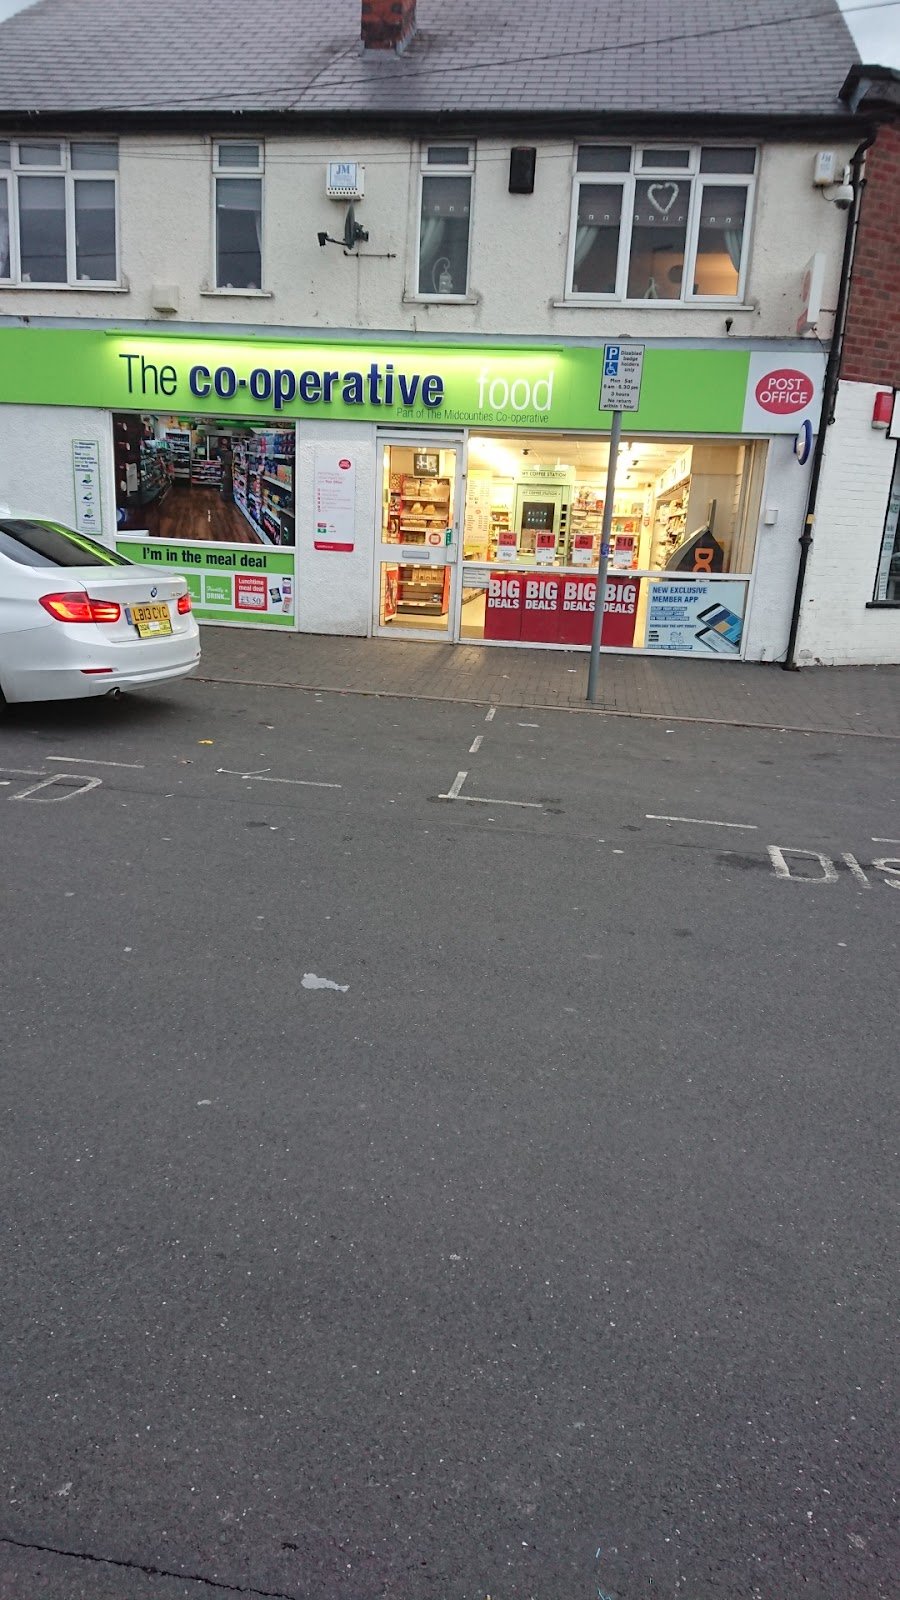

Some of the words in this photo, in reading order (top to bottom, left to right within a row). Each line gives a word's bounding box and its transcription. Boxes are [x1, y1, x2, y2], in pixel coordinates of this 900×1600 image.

[336, 164, 350, 174] JM
[609, 348, 618, 359] P
[119, 354, 177, 395] The
[476, 366, 554, 411] food
[768, 378, 804, 390] POST
[760, 391, 808, 404] OFFICE
[397, 407, 413, 418] Part
[416, 409, 424, 418] of
[427, 410, 442, 420] The
[444, 410, 493, 421] Midcounties
[496, 412, 549, 423] Co-operative
[617, 536, 634, 547] £10
[143, 547, 162, 560] I'm
[166, 549, 177, 562] in
[182, 550, 201, 563] the
[206, 553, 236, 566] meal
[241, 554, 267, 568] deal
[489, 580, 519, 598] BIG
[526, 581, 558, 599] BIG
[565, 582, 597, 601] BIG
[605, 584, 636, 603] BIG
[152, 606, 168, 619] CYC
[488, 598, 519, 609] DEALS
[525, 600, 557, 610] DEALS
[563, 601, 596, 612] DEALS
[603, 602, 635, 614] DEALS
